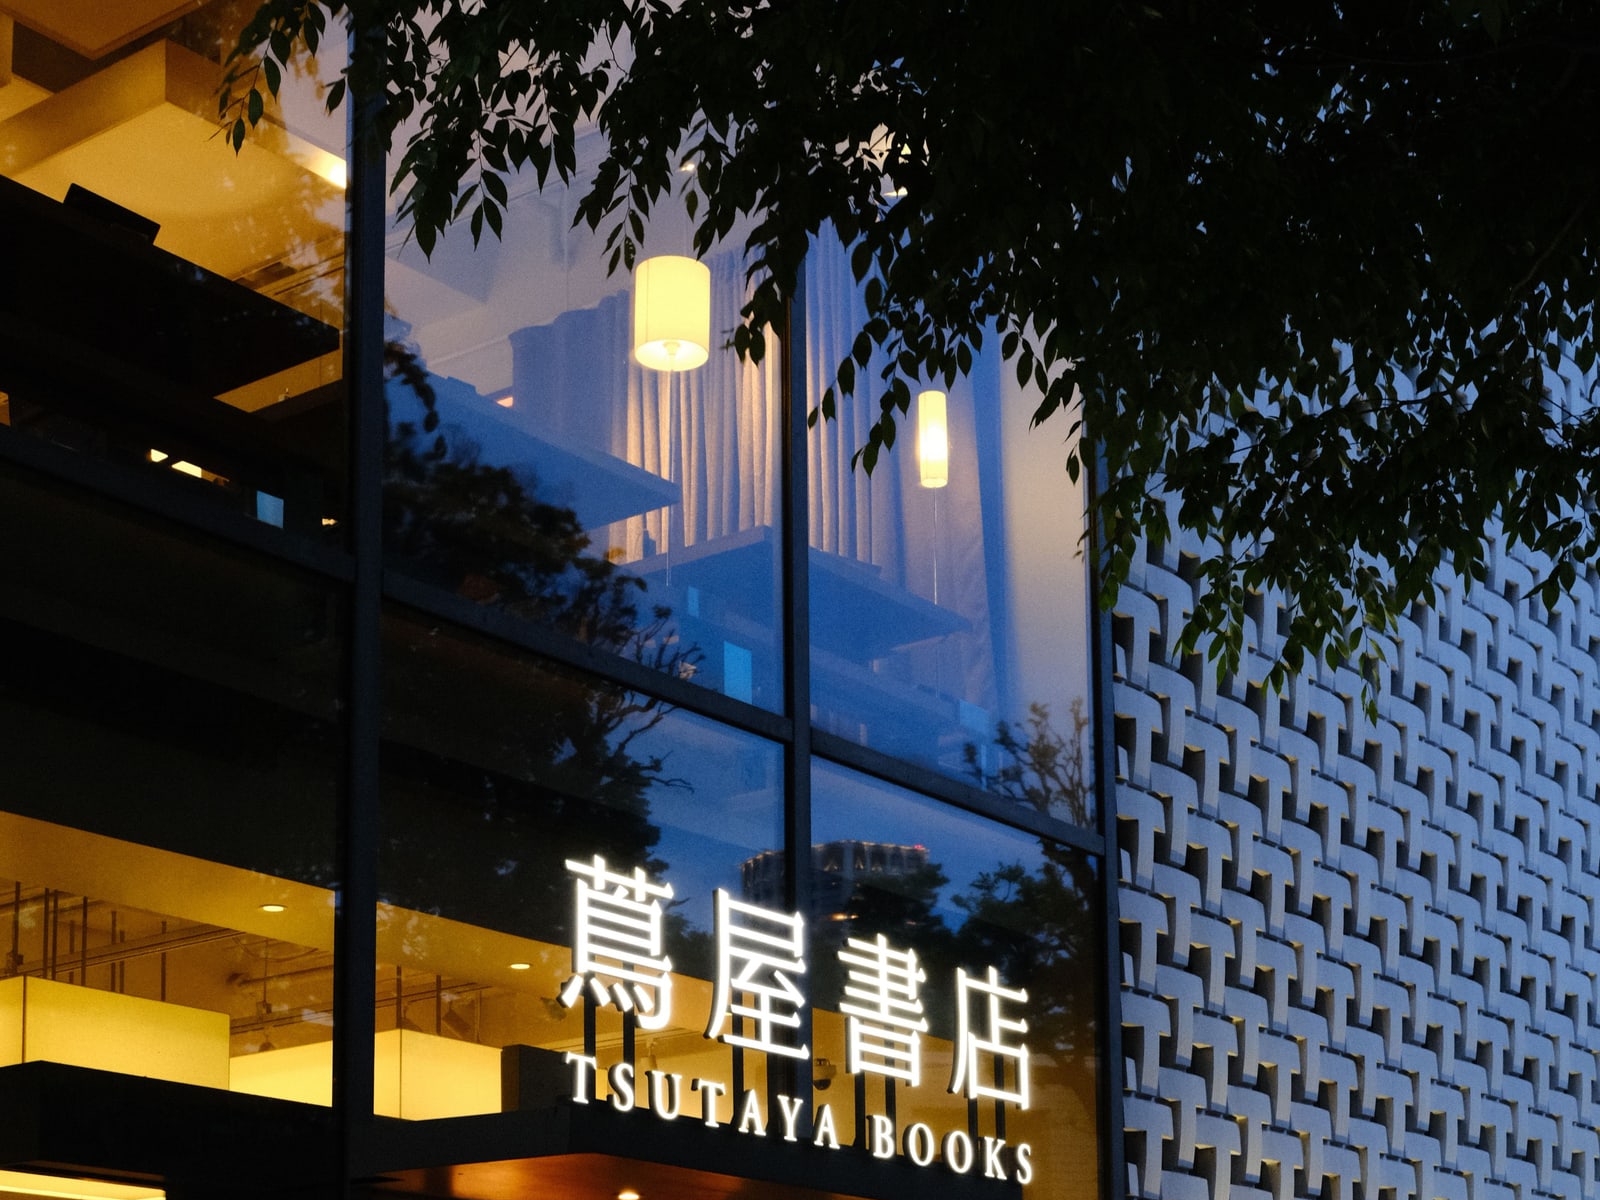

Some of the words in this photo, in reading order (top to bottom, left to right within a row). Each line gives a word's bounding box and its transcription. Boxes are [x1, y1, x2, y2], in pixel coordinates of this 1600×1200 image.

[560, 854, 1032, 1111] 蔦屋書店
[565, 1051, 841, 1150] TSUTAYA
[868, 1114, 1033, 1186] BOOKS
